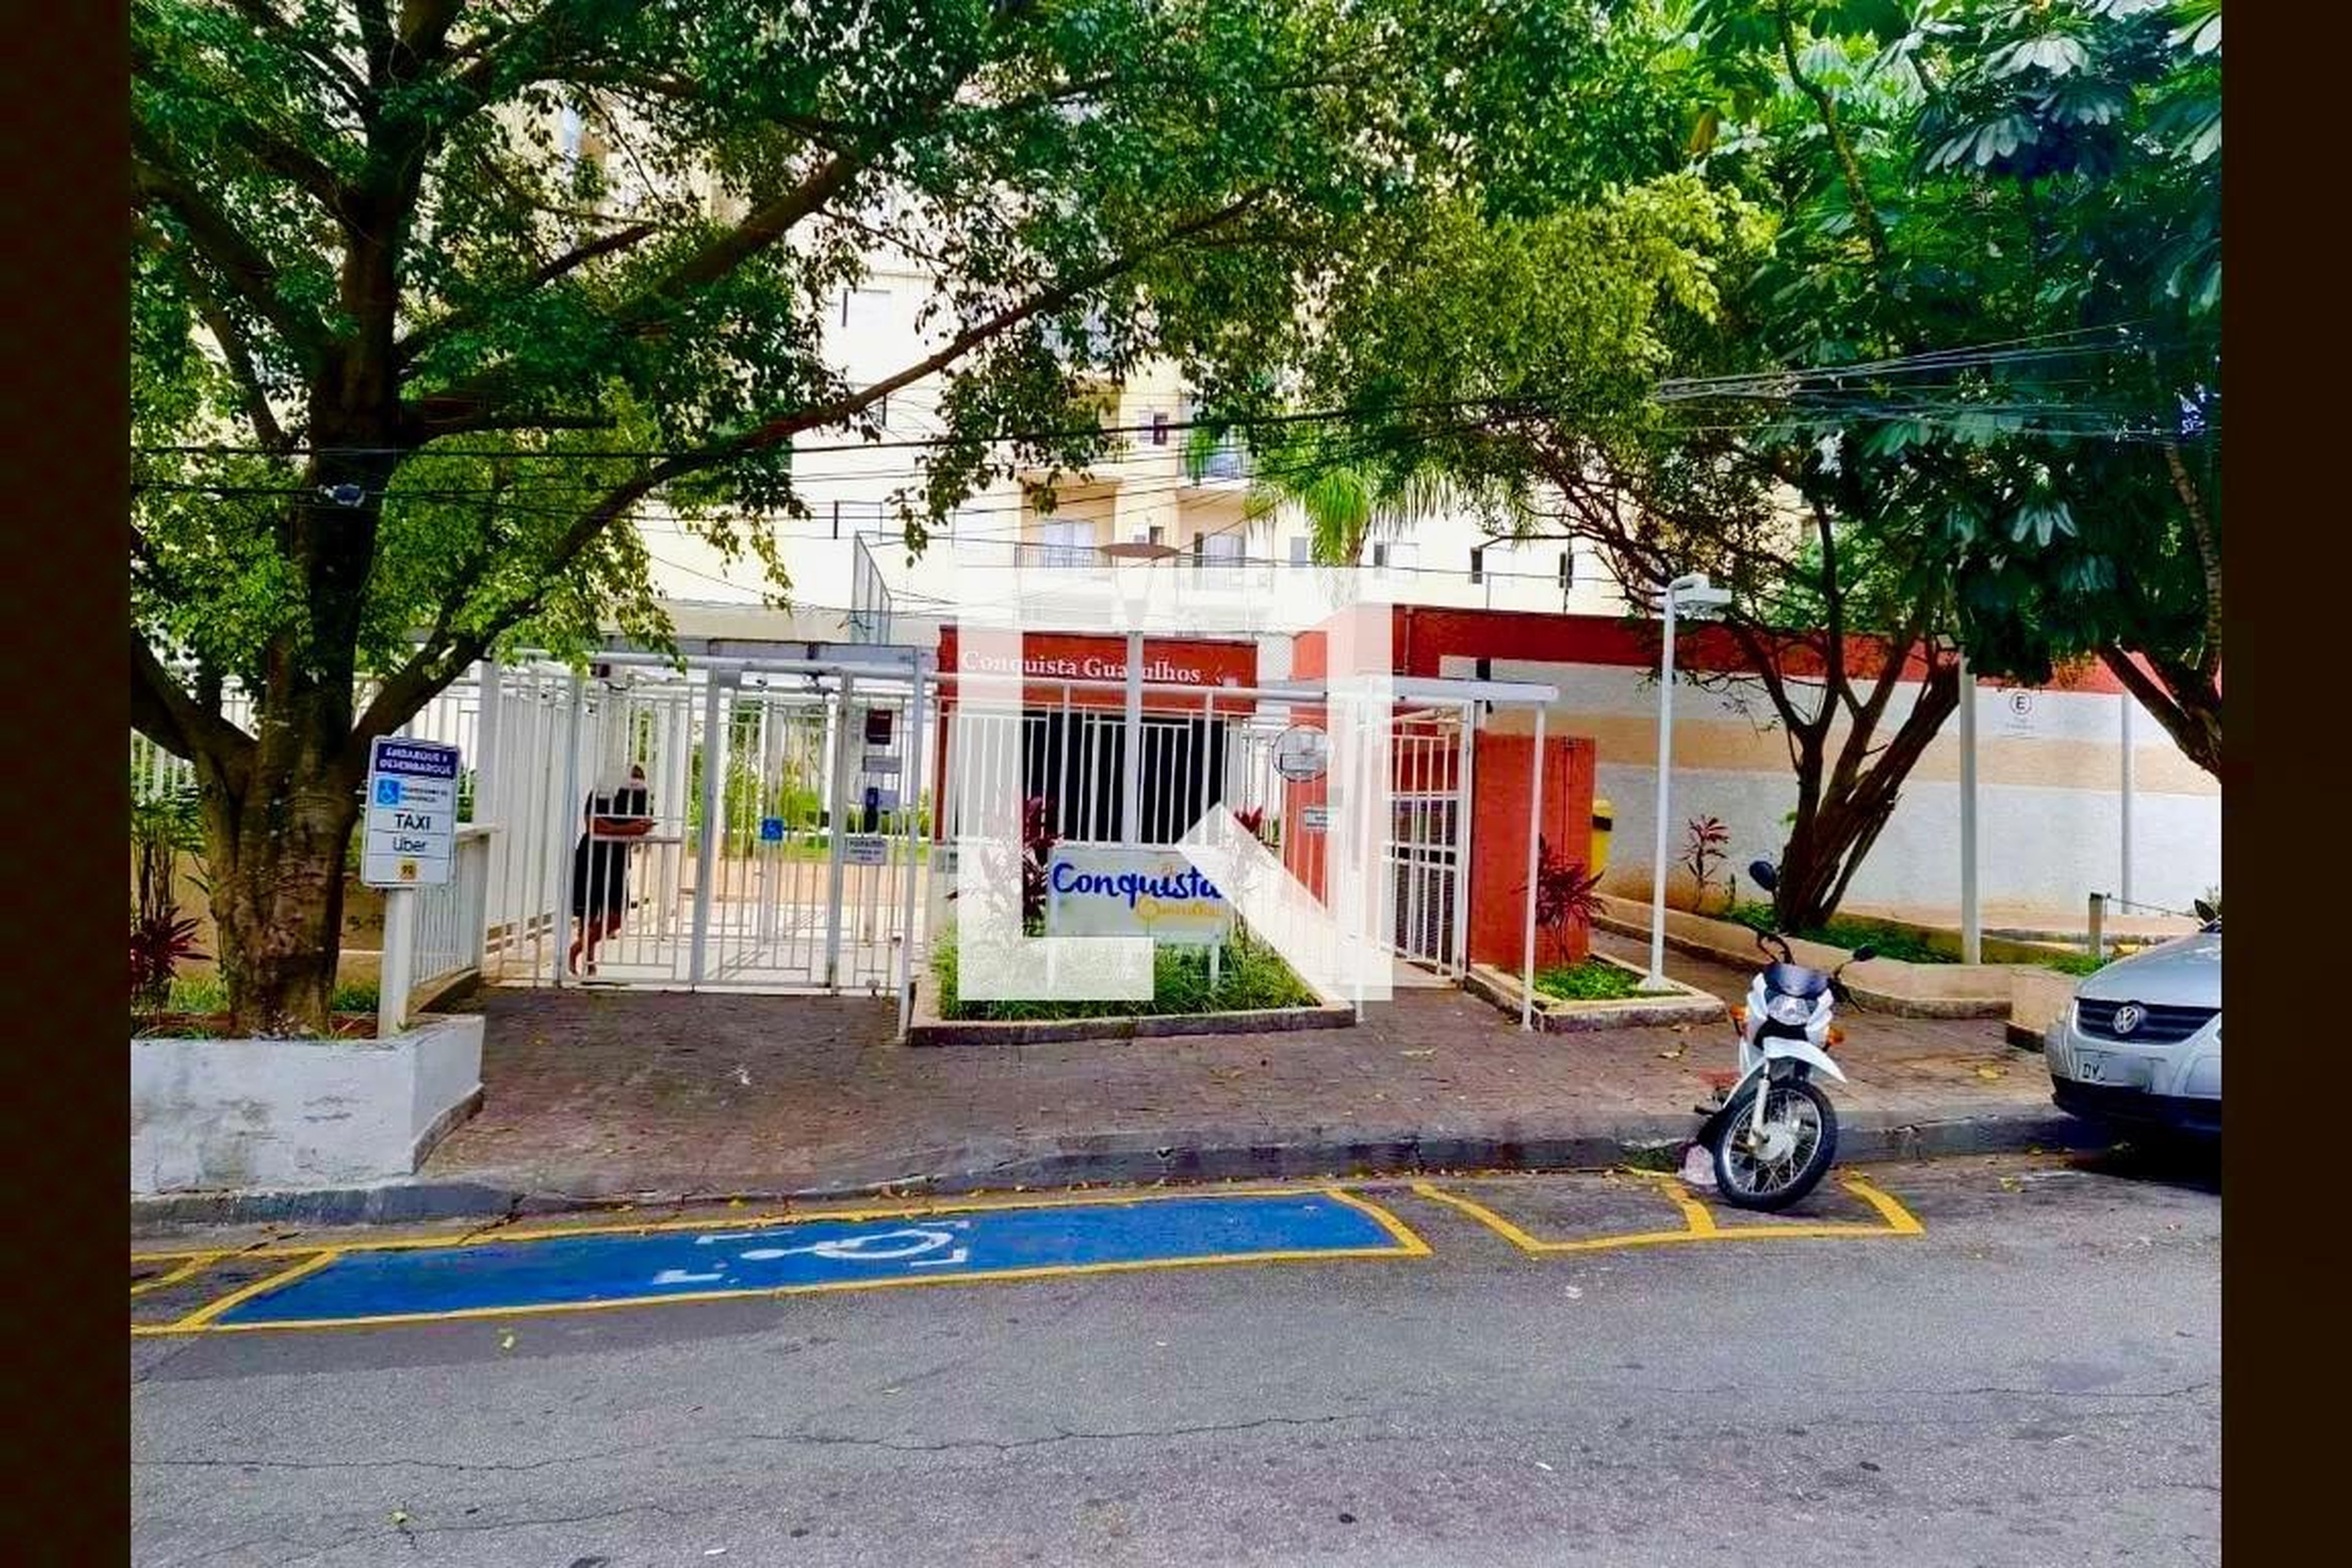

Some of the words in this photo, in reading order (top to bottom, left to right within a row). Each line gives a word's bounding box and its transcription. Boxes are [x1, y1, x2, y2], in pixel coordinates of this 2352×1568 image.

[962, 650, 1077, 676] Conquista
[1084, 658, 1200, 683] Guaulhos
[2016, 696, 2026, 710] E
[394, 813, 431, 831] TAXI
[393, 837, 428, 853] Uber
[1052, 862, 1223, 910] Conquista
